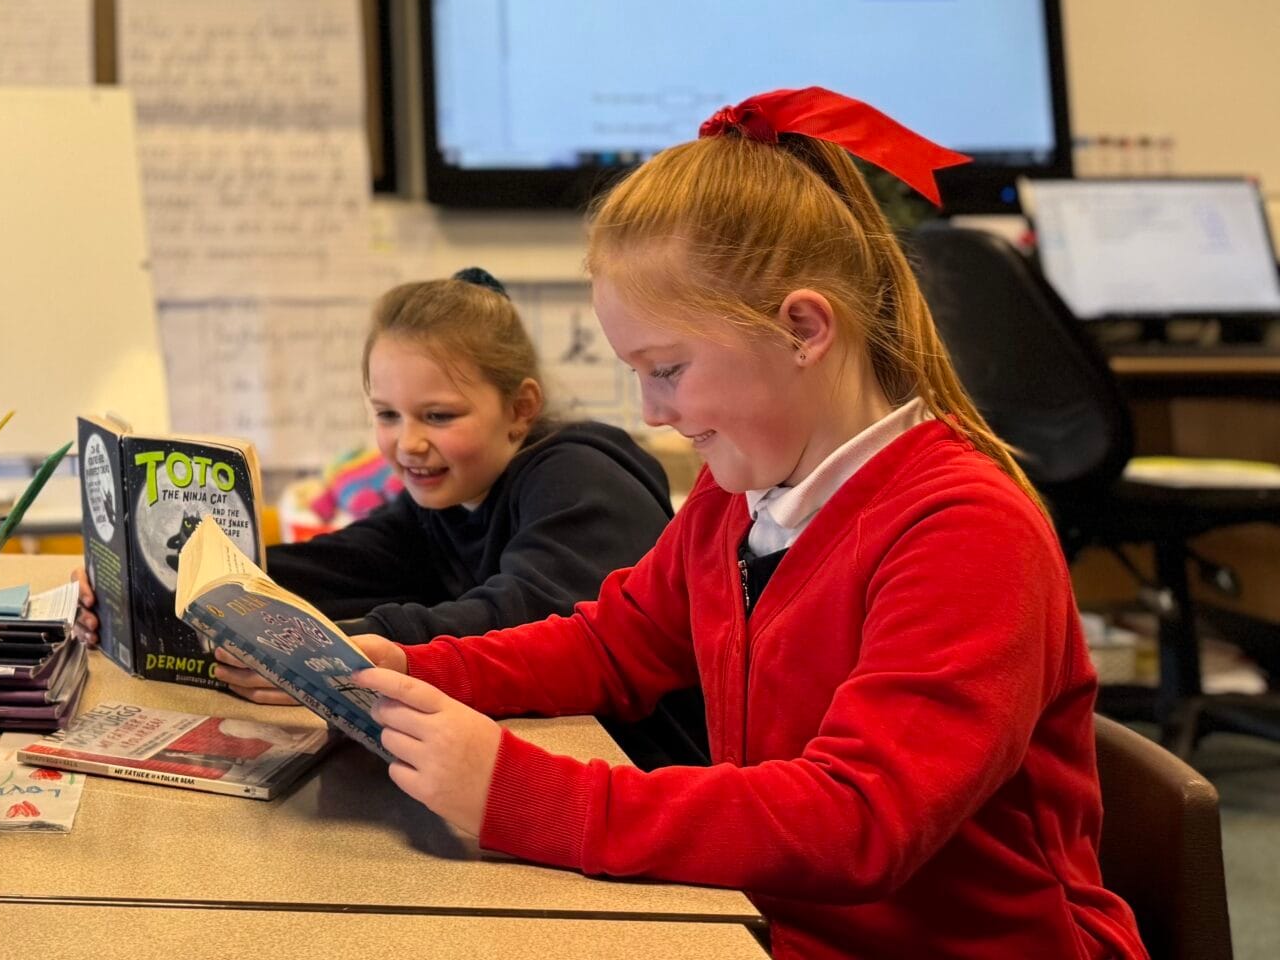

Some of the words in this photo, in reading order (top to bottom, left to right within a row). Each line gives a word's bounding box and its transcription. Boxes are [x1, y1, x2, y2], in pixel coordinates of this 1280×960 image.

[135, 451, 235, 507] TOTO
[162, 489, 179, 501] THE
[182, 492, 207, 502] NINJA
[210, 494, 227, 505] CAT
[212, 507, 225, 516] AND
[227, 509, 240, 518] THE
[228, 520, 249, 529] SNAKE
[146, 653, 205, 674] DERMOT
[124, 769, 150, 779] FATHER
[160, 774, 180, 783] POLAR
[180, 777, 196, 785] BEAR
